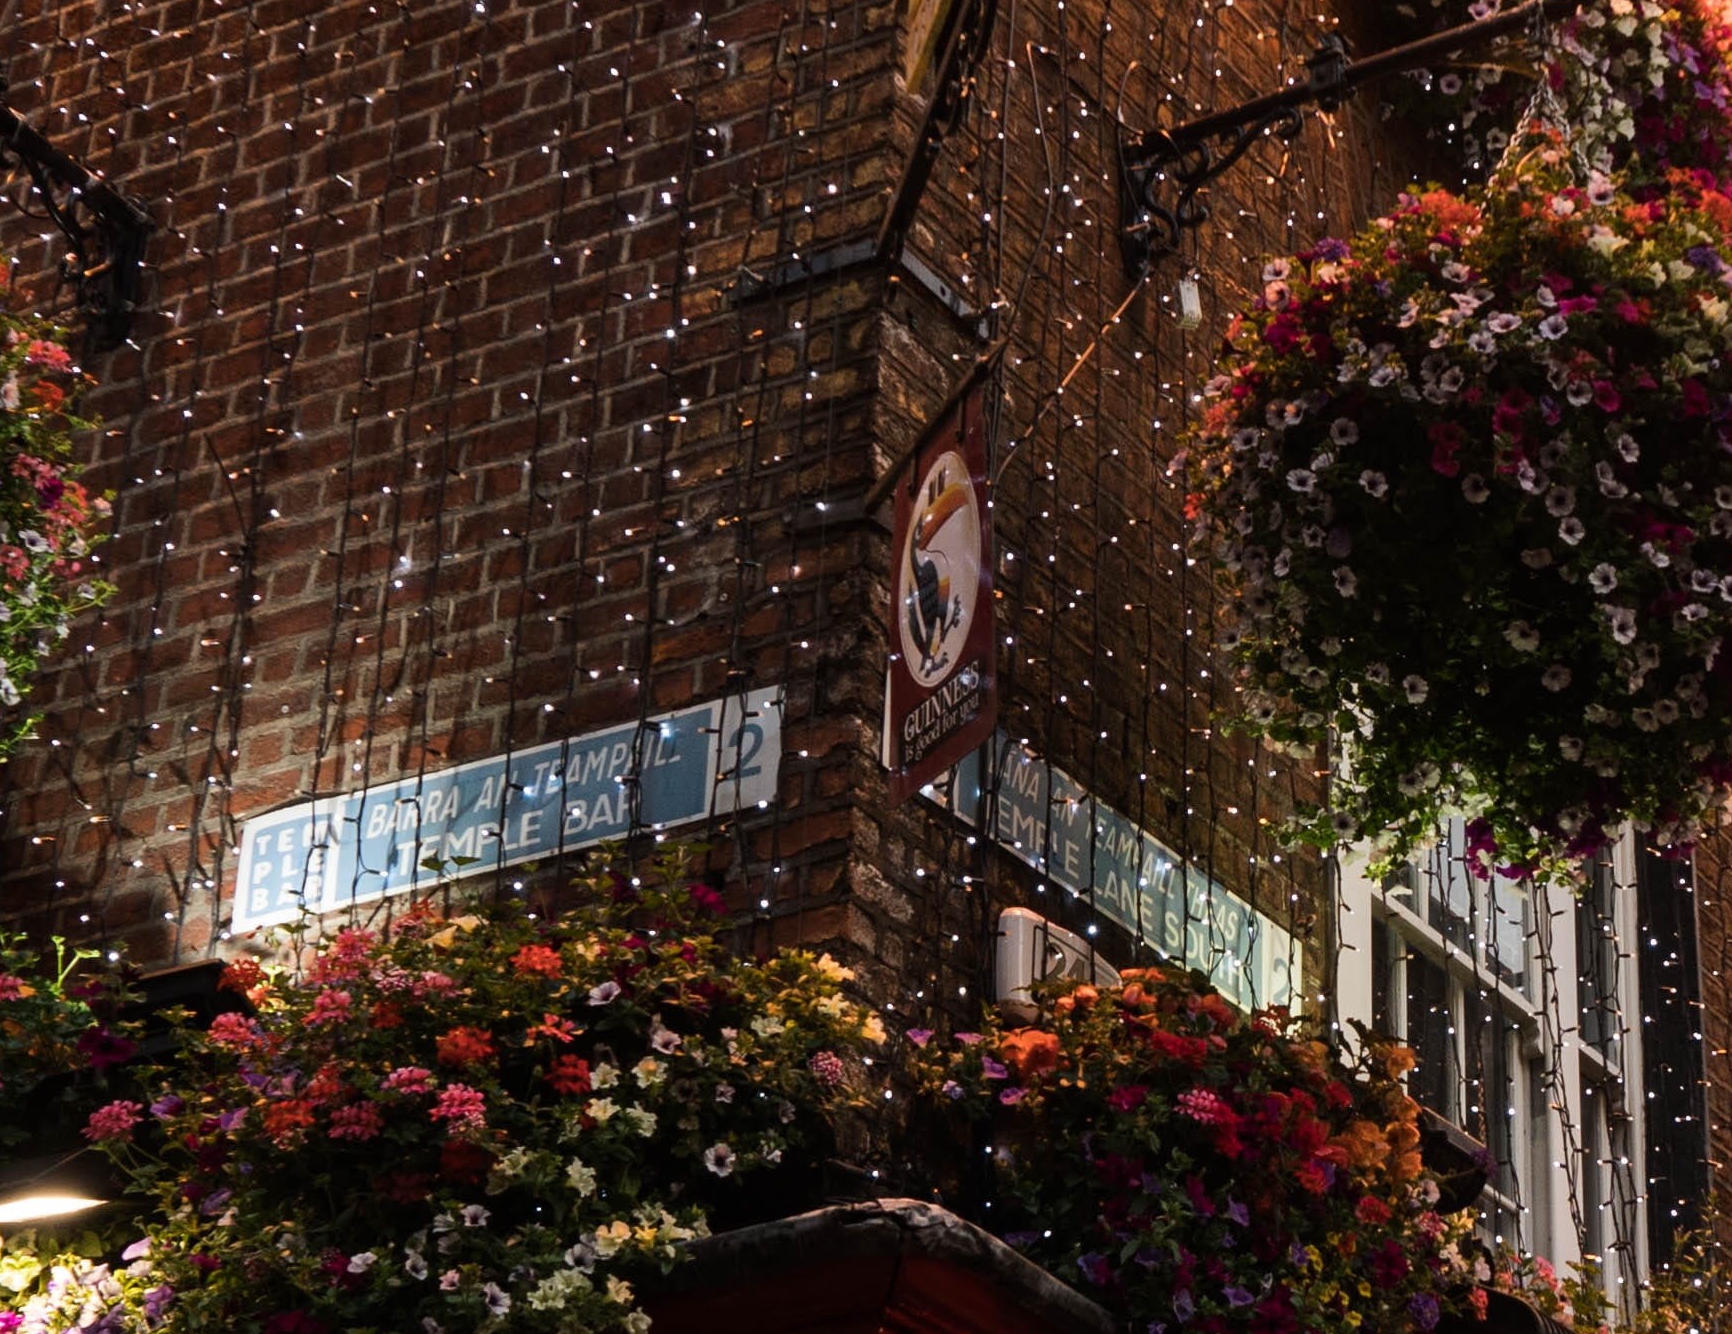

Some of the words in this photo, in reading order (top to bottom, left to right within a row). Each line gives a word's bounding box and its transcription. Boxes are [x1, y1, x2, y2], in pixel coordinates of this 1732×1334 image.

[904, 659, 981, 742] GUINNESS
[728, 722, 764, 781] 2
[365, 785, 460, 840] BARRA
[473, 769, 519, 813] AN
[395, 810, 544, 876] TEMPLE
